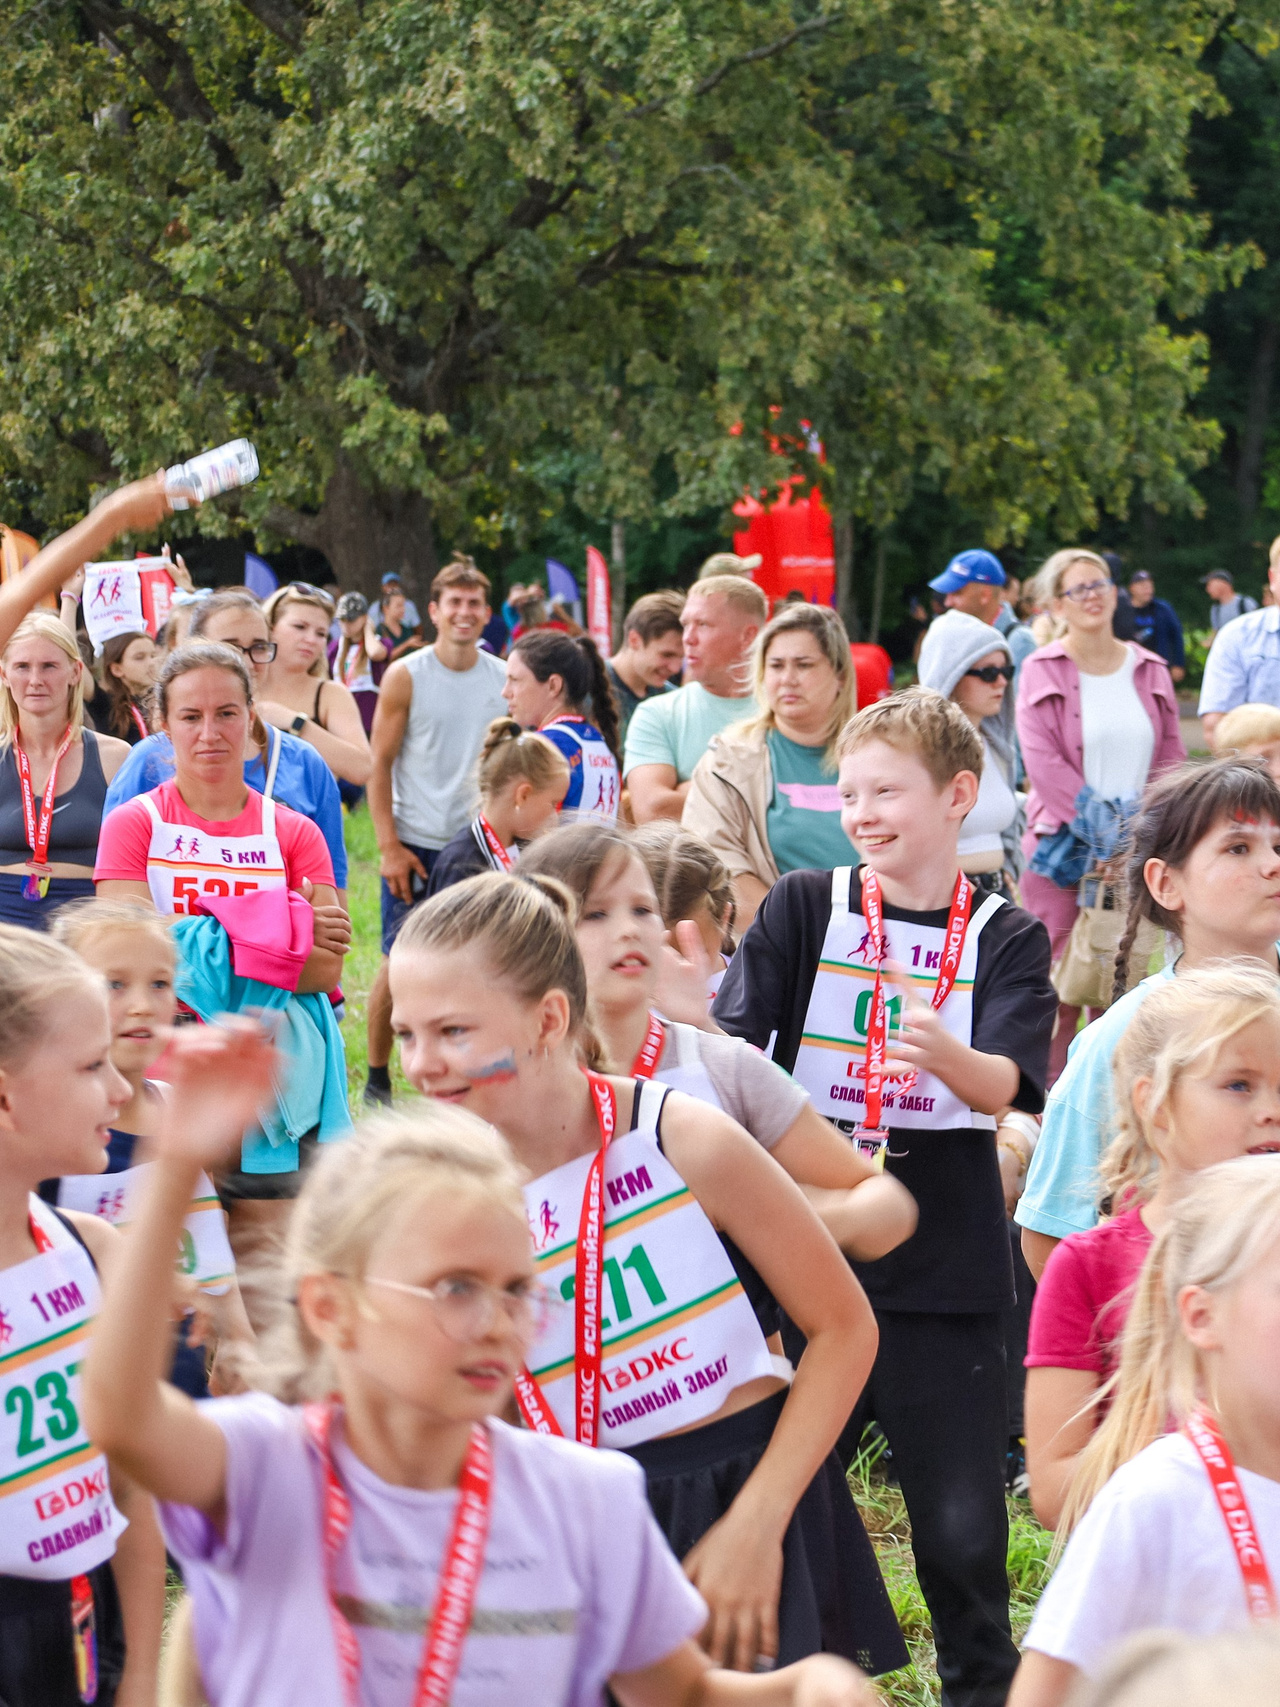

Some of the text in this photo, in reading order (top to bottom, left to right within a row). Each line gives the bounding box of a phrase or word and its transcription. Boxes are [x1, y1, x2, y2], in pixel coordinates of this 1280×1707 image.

[39, 812, 50, 834] DKC
[221, 848, 267, 865] 5 КМ
[910, 944, 943, 969] 1 К
[944, 932, 962, 969] DKC
[868, 1037, 884, 1075] DKC
[898, 1095, 936, 1113] ЗАБЕГ
[606, 1165, 654, 1206] КМ
[580, 1083, 614, 1421] DKC #СЛАВНЫЙЗАБЕГ DKC
[30, 1281, 86, 1322] 1 КМ
[626, 1336, 694, 1383] DKC
[602, 1354, 729, 1430] СЛАВНЫЙ ЗАБЕГ
[27, 1507, 105, 1563] СЛАВНЫЙ
[1226, 1508, 1263, 1567] DKC
